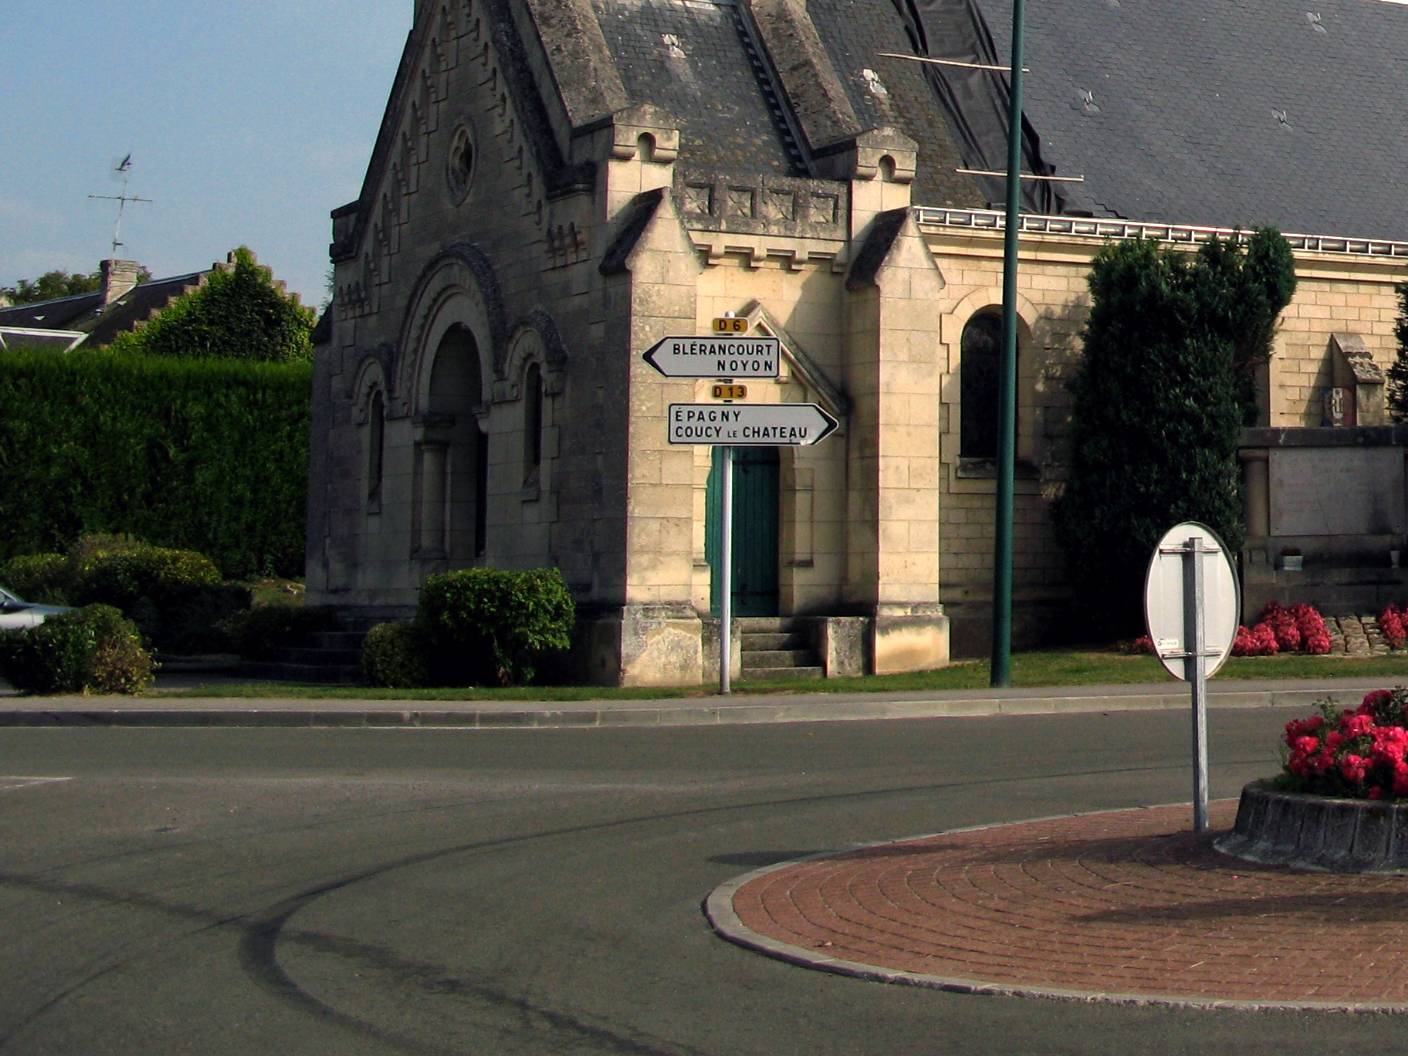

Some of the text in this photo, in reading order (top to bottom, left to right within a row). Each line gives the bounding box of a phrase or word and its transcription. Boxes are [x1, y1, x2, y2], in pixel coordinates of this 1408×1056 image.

[718, 320, 741, 331] D 6
[672, 341, 773, 356] BLÉRANCOURT
[717, 360, 773, 372] NOYON
[714, 387, 745, 398] D 13
[675, 408, 742, 422] ÉPAGNY
[675, 426, 808, 439] COUCY LE CHATEAU
